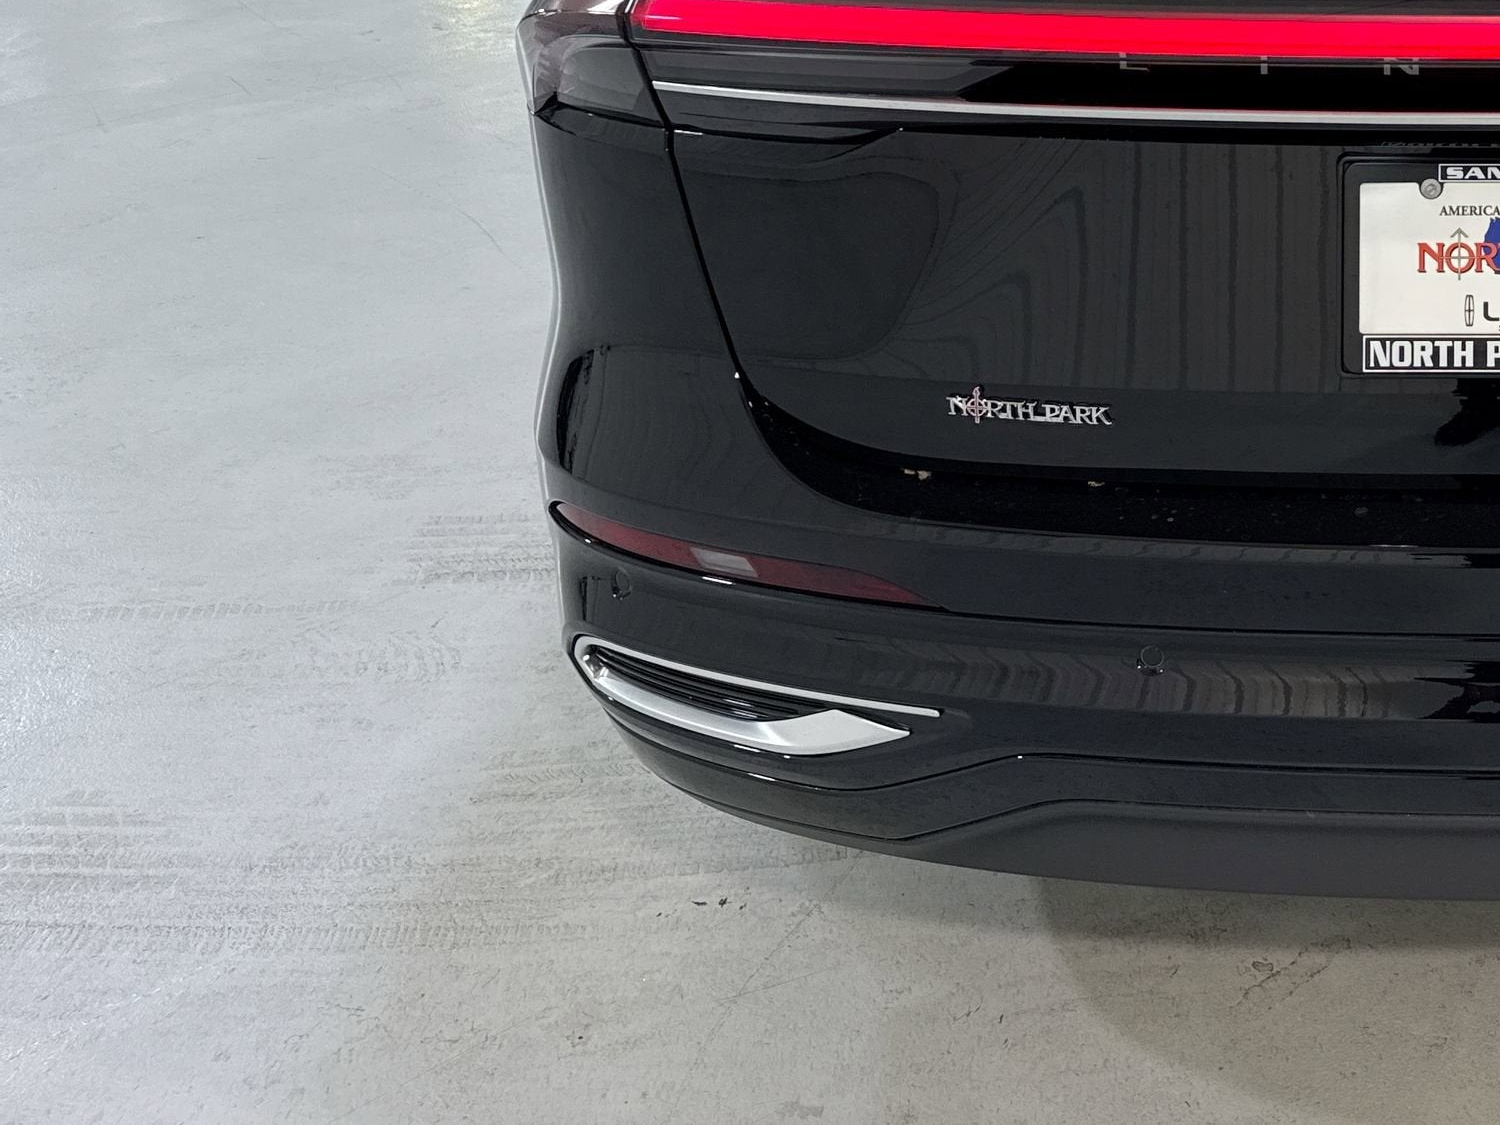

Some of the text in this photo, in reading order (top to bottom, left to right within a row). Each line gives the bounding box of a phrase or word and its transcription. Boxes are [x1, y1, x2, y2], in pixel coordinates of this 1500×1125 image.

[1369, 340, 1474, 368] NORTH
[946, 391, 1113, 426] NORTH PARK
